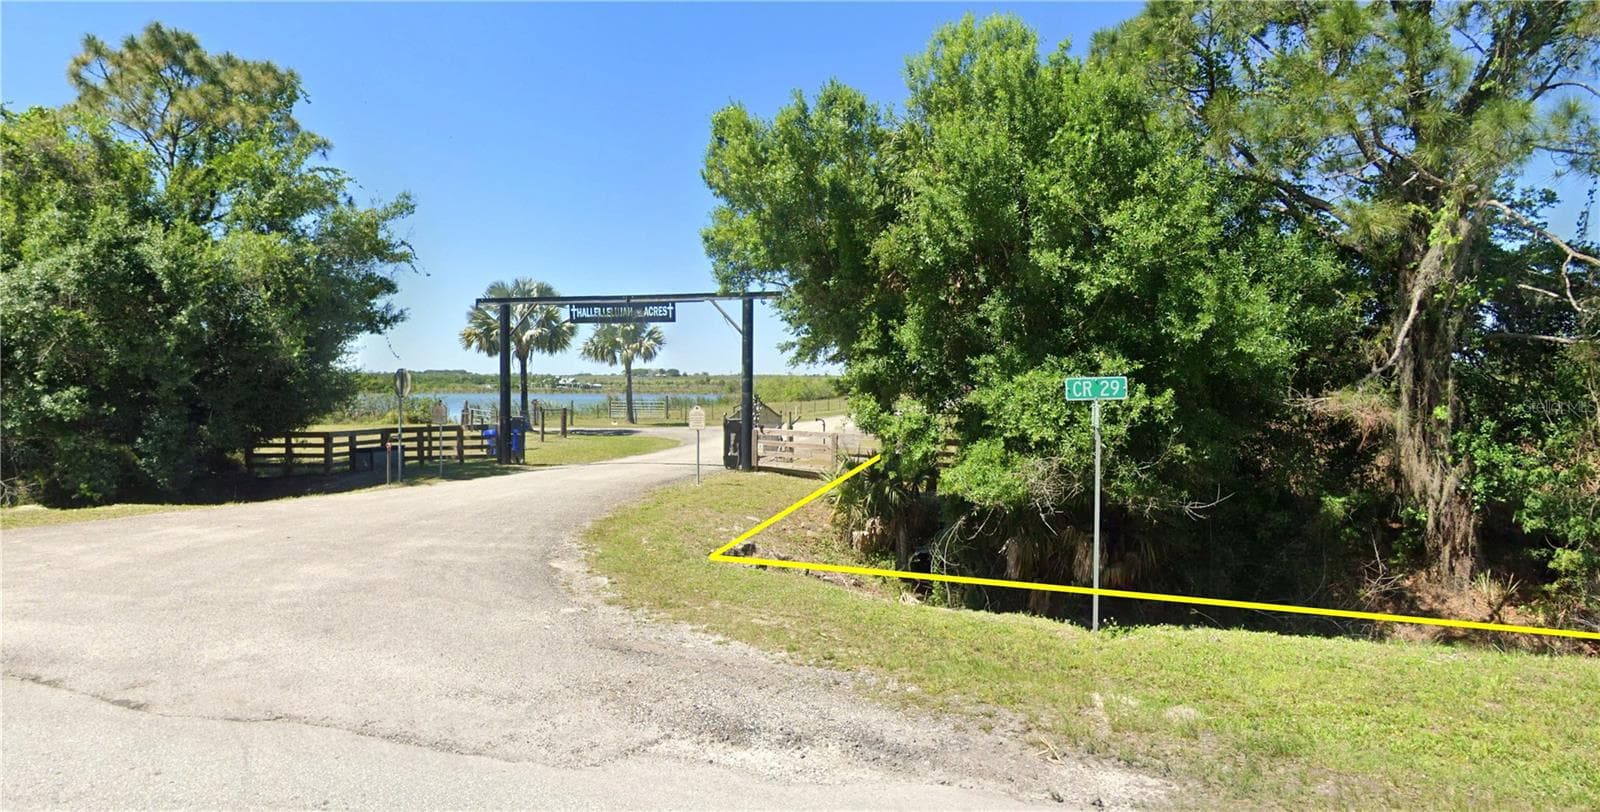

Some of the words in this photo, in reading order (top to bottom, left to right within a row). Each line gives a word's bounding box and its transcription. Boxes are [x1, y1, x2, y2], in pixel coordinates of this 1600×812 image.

[643, 305, 668, 317] ACRES
[1072, 381, 1092, 397] CR
[1100, 380, 1120, 396] 29
